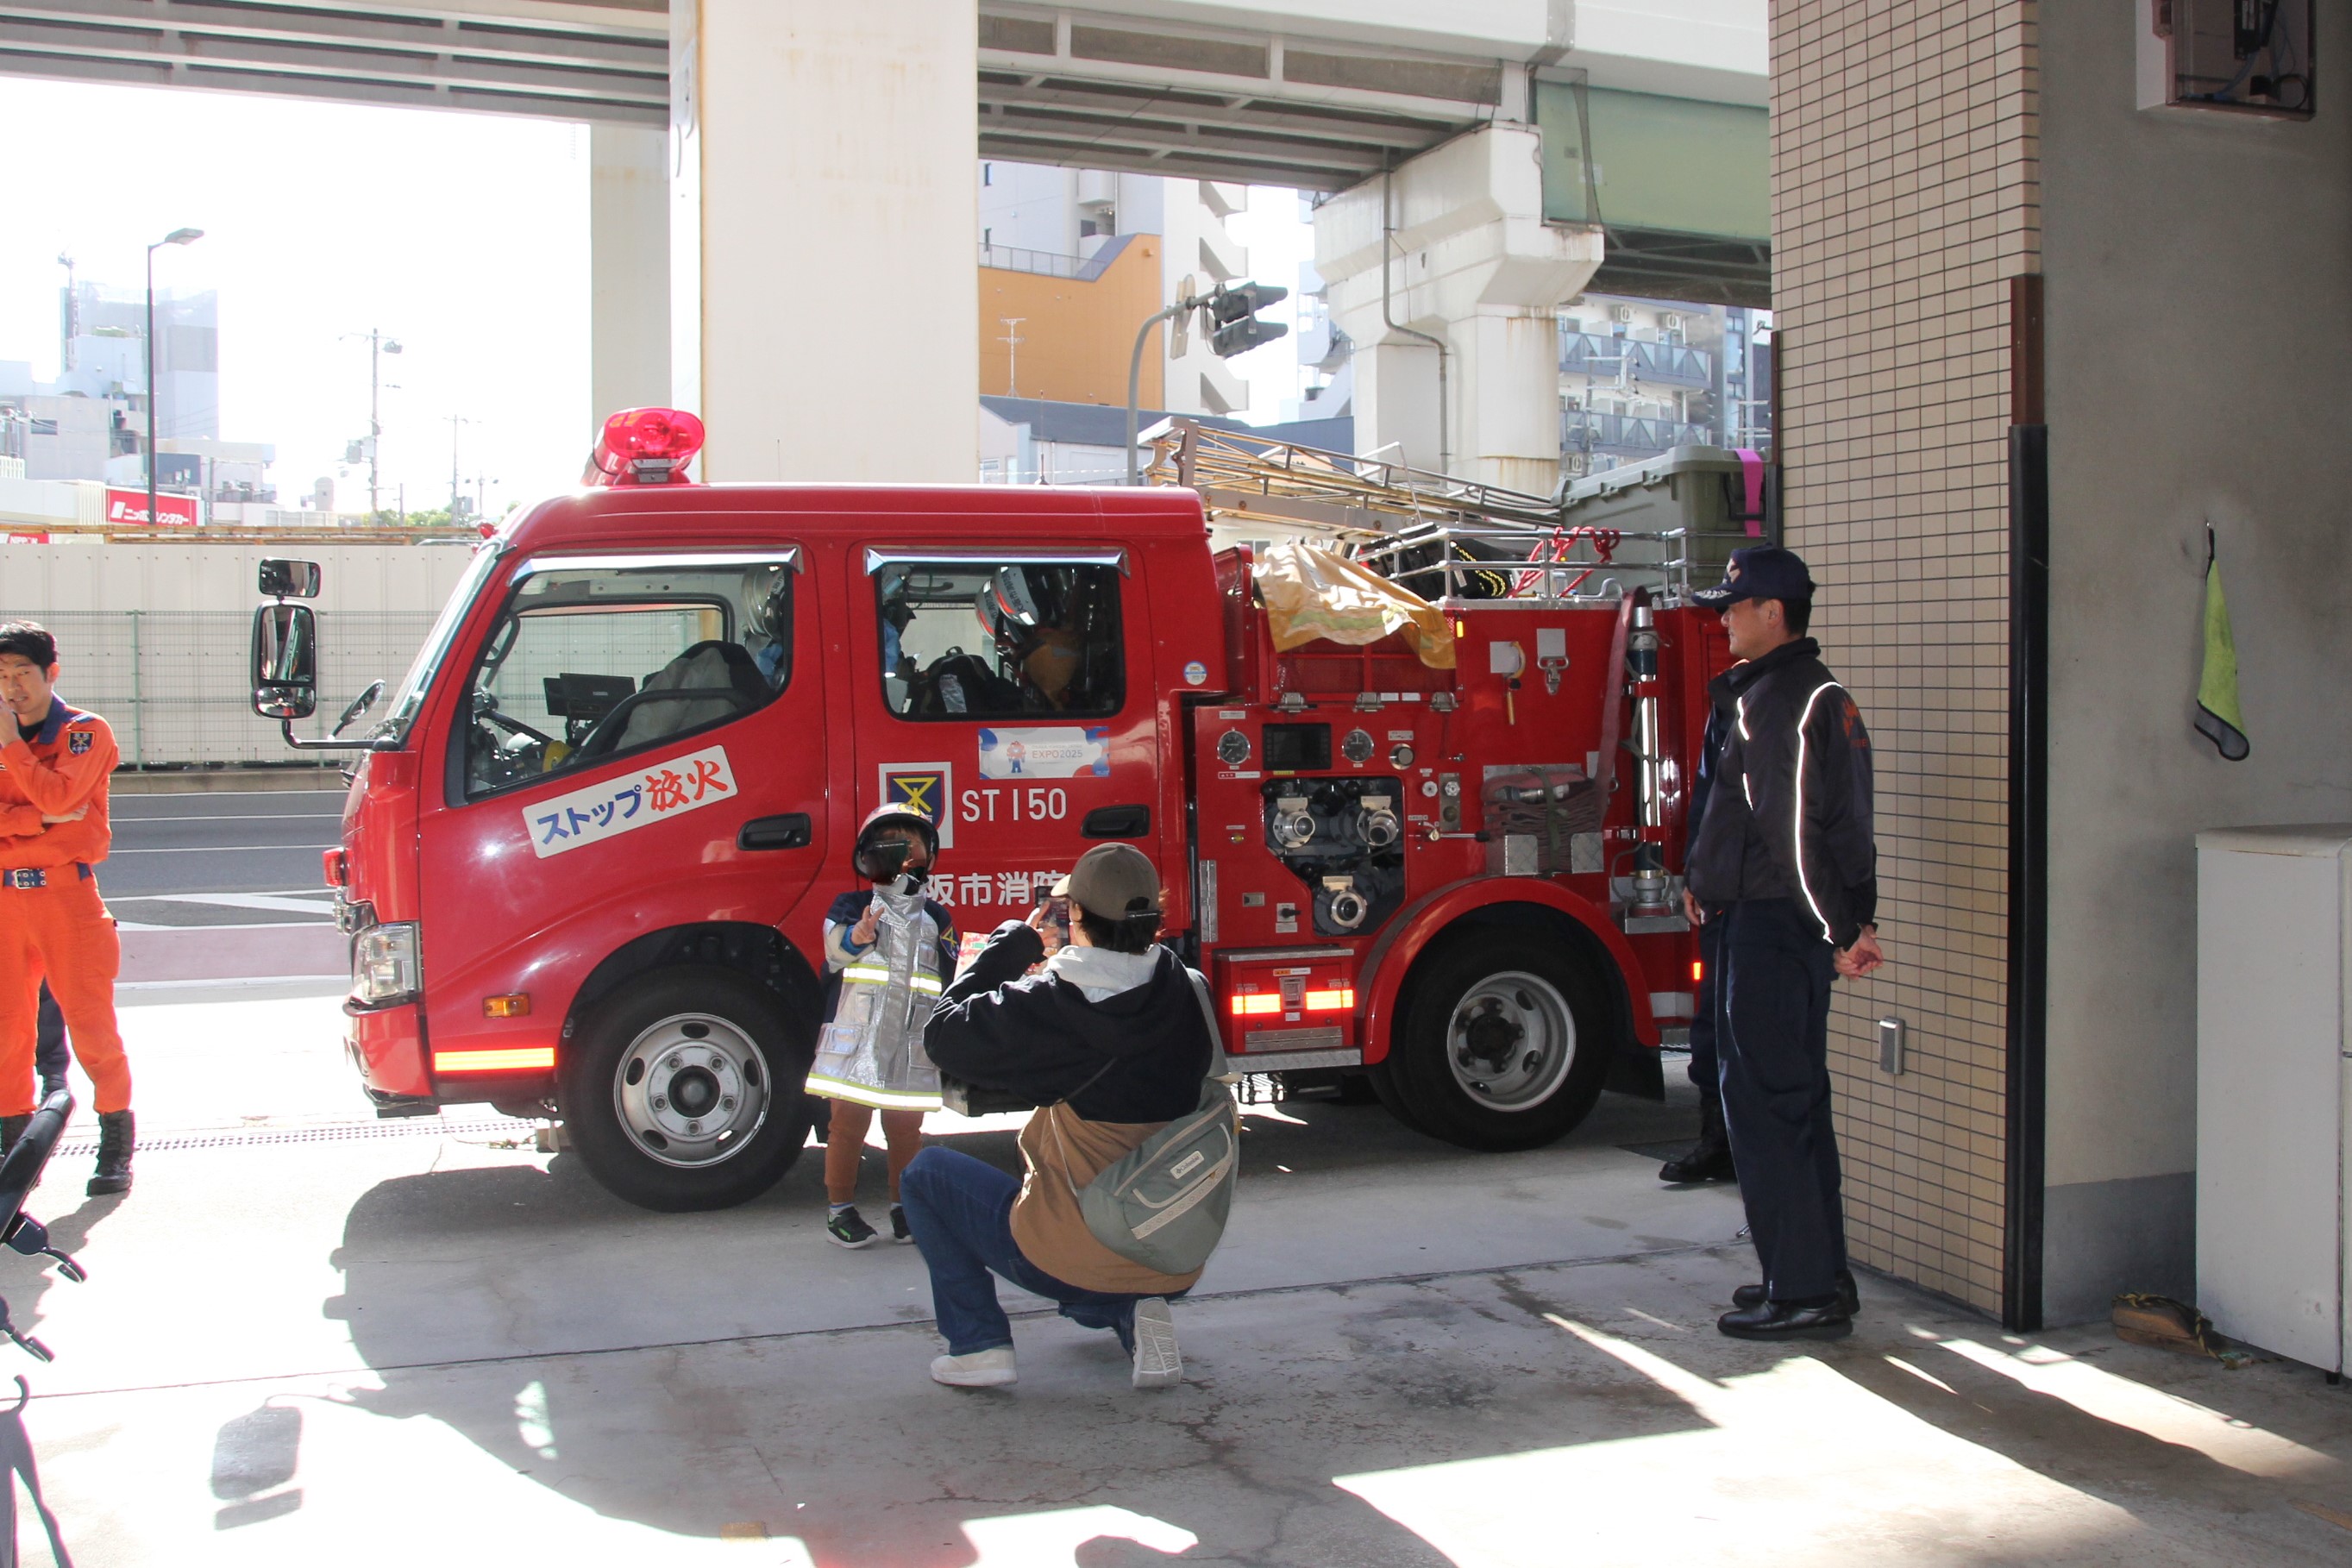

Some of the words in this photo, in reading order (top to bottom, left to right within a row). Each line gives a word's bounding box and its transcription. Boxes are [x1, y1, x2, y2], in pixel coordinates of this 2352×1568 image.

[1032, 750, 1083, 759] EXPO2025
[537, 760, 728, 844] ストップ放火
